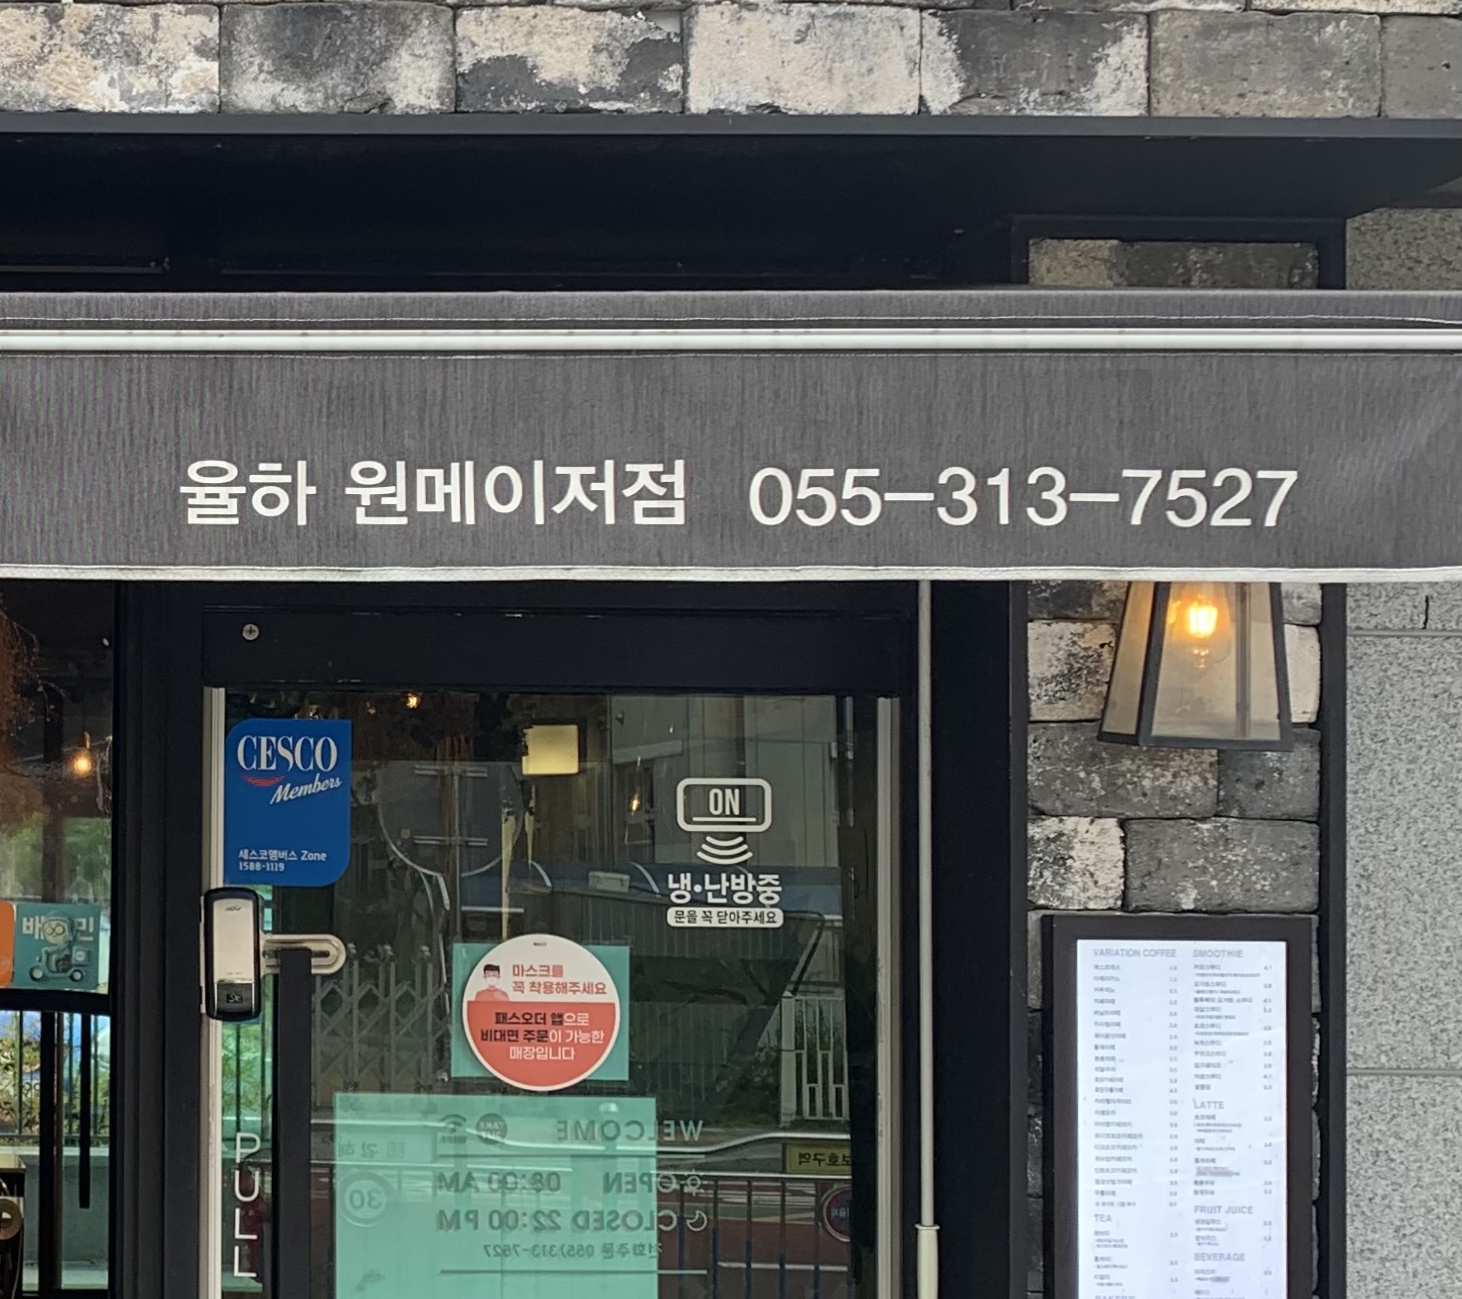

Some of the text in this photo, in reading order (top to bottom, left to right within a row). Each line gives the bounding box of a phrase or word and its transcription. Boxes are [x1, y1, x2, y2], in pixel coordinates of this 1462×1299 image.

[179, 458, 1299, 529] 율하 원메이저점 055-313-7527
[237, 735, 338, 772] CESCO
[269, 773, 343, 805] Members
[708, 788, 741, 816] ON
[301, 850, 327, 862] Zone
[239, 862, 285, 872] 1588-1119
[674, 910, 777, 924] 문을 꼭 닫아주세요
[1093, 948, 1177, 958] VARIATION COFFEE
[1193, 949, 1244, 958] SMOOTHIE
[512, 964, 564, 978] 마스크를
[512, 981, 608, 995] 꼭 착용해주세요
[495, 1012, 590, 1026] 패스오더 앱으로
[480, 1029, 605, 1044] 비대면 주문이 가능한
[509, 1046, 575, 1060] 매장입니다
[1193, 1099, 1225, 1109] LATTE
[233, 1132, 262, 1278] PULL
[1194, 1205, 1254, 1215] FRUIT JUICE
[1094, 1213, 1112, 1222] TEA
[1194, 1252, 1246, 1262] BEVERAGE
